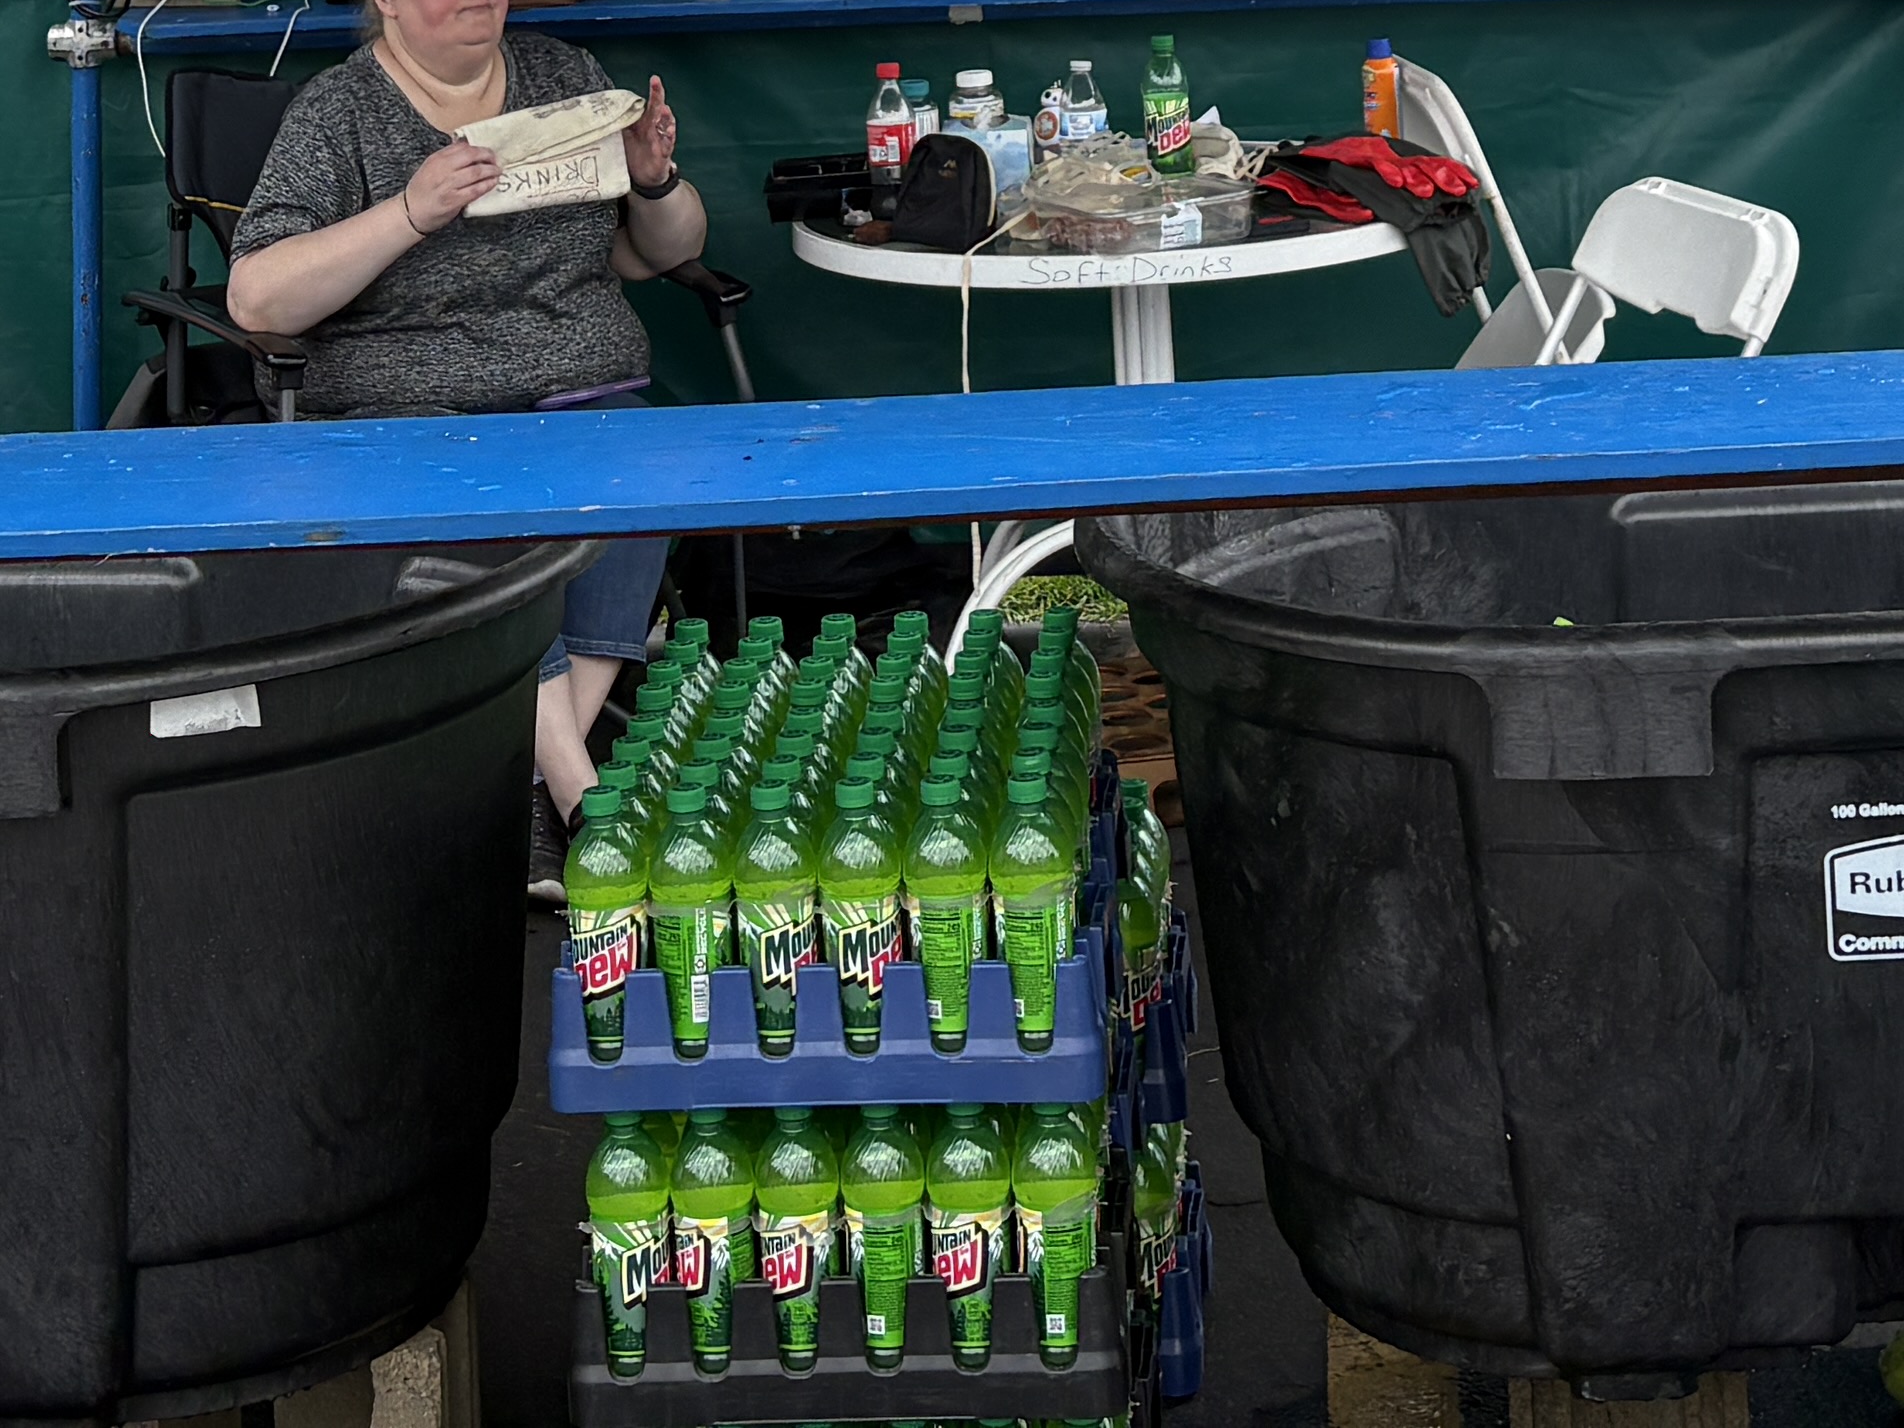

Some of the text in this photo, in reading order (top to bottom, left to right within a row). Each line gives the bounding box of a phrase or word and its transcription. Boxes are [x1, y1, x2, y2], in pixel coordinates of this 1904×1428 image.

[1021, 255, 1233, 285] Soft Drinks
[1830, 804, 1857, 819] 100
